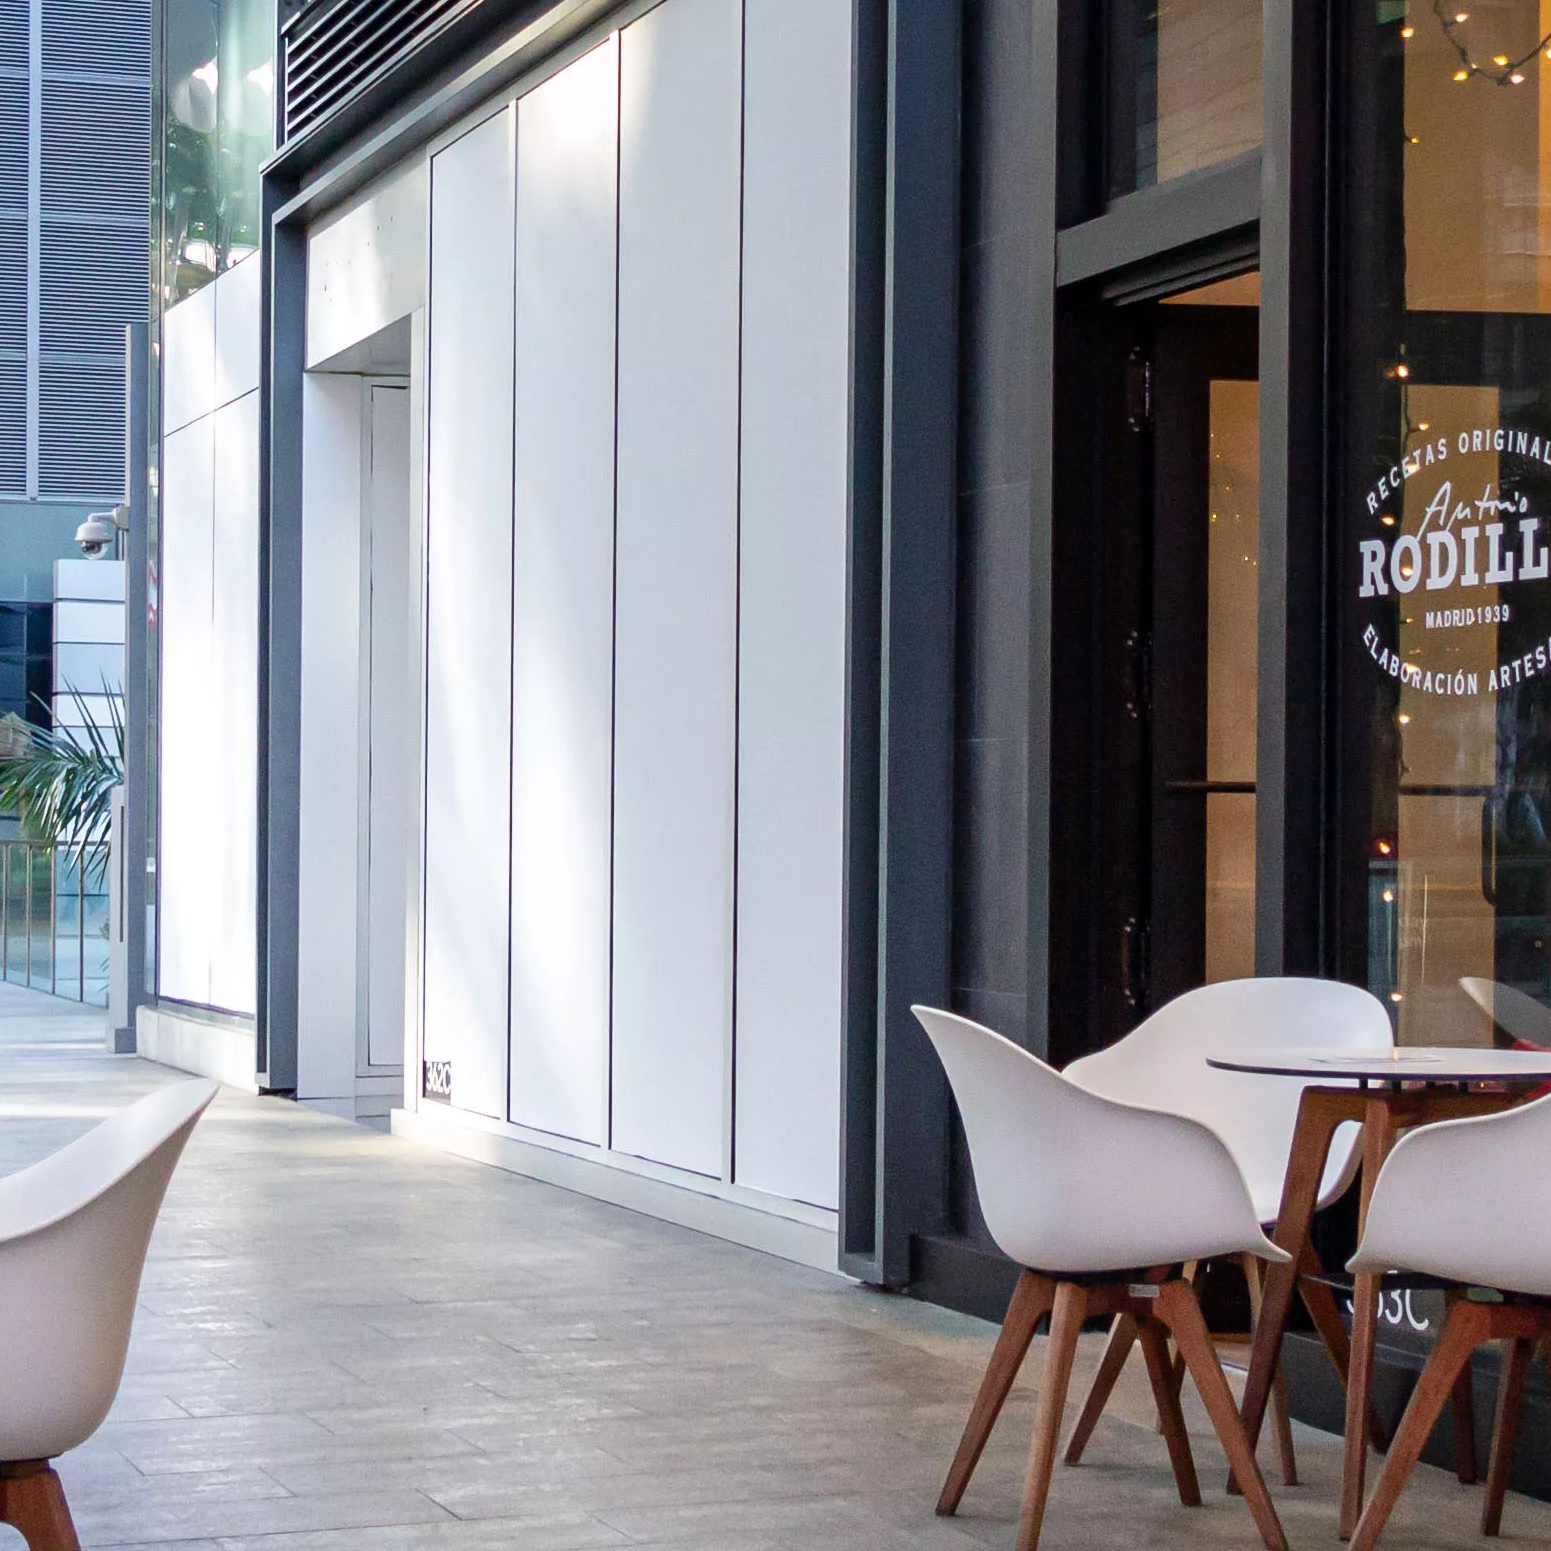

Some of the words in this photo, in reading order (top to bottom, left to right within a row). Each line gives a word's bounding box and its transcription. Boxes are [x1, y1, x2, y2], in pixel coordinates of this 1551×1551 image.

[1366, 437, 1448, 515] RECETAS
[1425, 608, 1474, 630] MADRID
[1361, 623, 1479, 697] ELABORACIÓN
